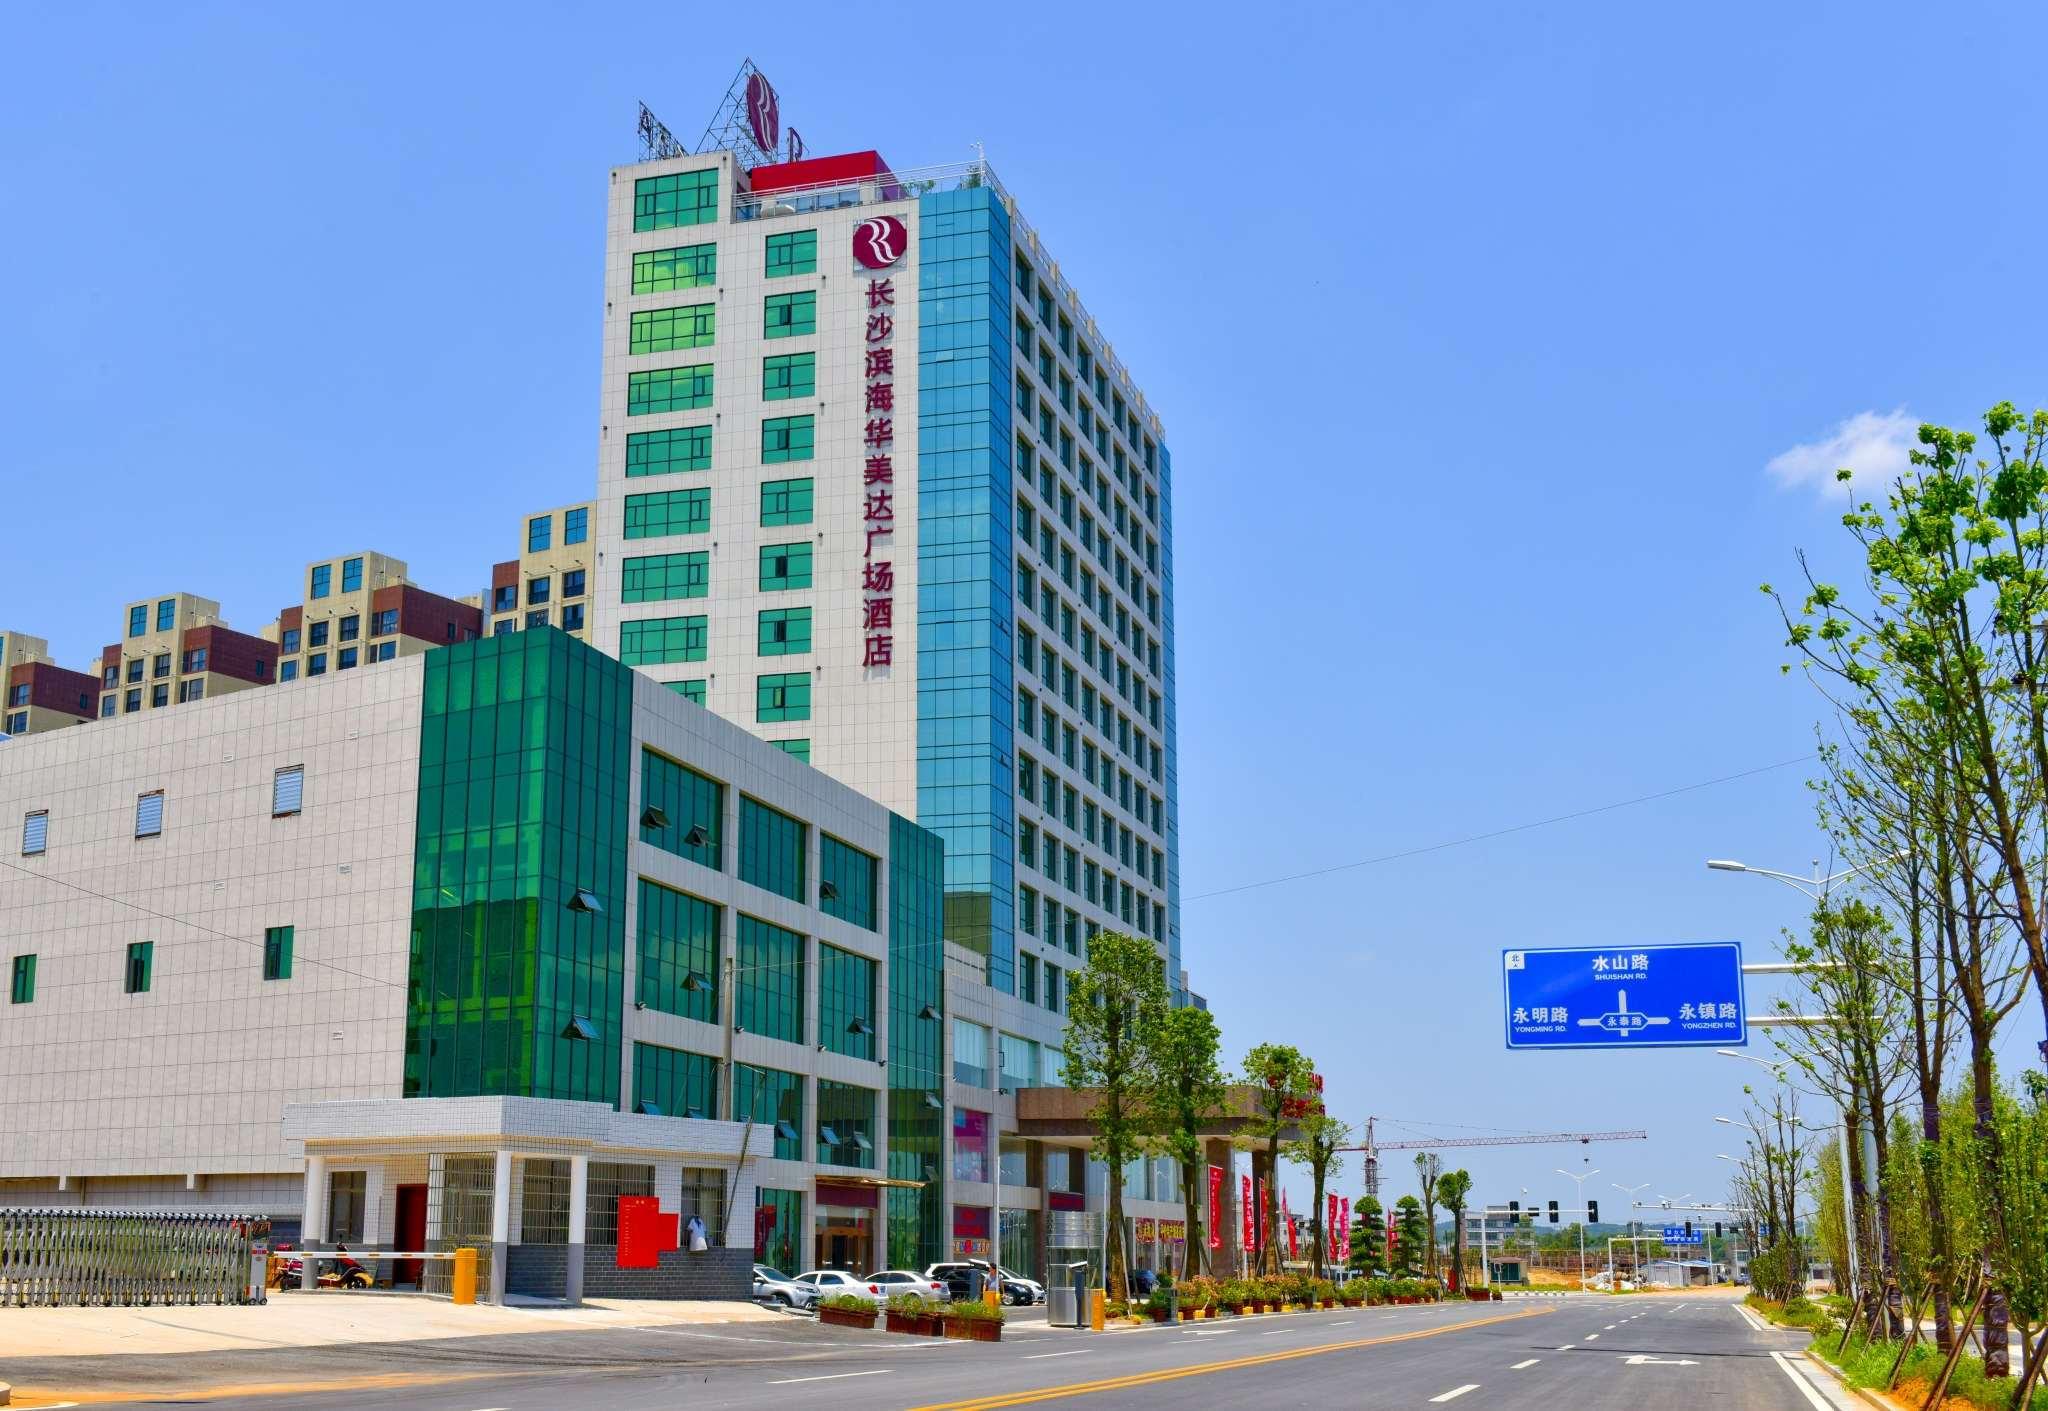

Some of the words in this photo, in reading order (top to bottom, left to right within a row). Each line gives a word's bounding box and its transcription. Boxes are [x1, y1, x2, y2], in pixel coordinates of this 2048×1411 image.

[862, 277, 895, 668] 长沙滨海华美达广场酒店
[1592, 953, 1649, 972] 水山路
[1594, 973, 1634, 981] SHUISHAN
[1513, 1006, 1568, 1024] 永明路
[1679, 1002, 1737, 1021] 永镇路
[1514, 1025, 1554, 1033] YONGMING
[1681, 1022, 1723, 1030] YONGZHEN
